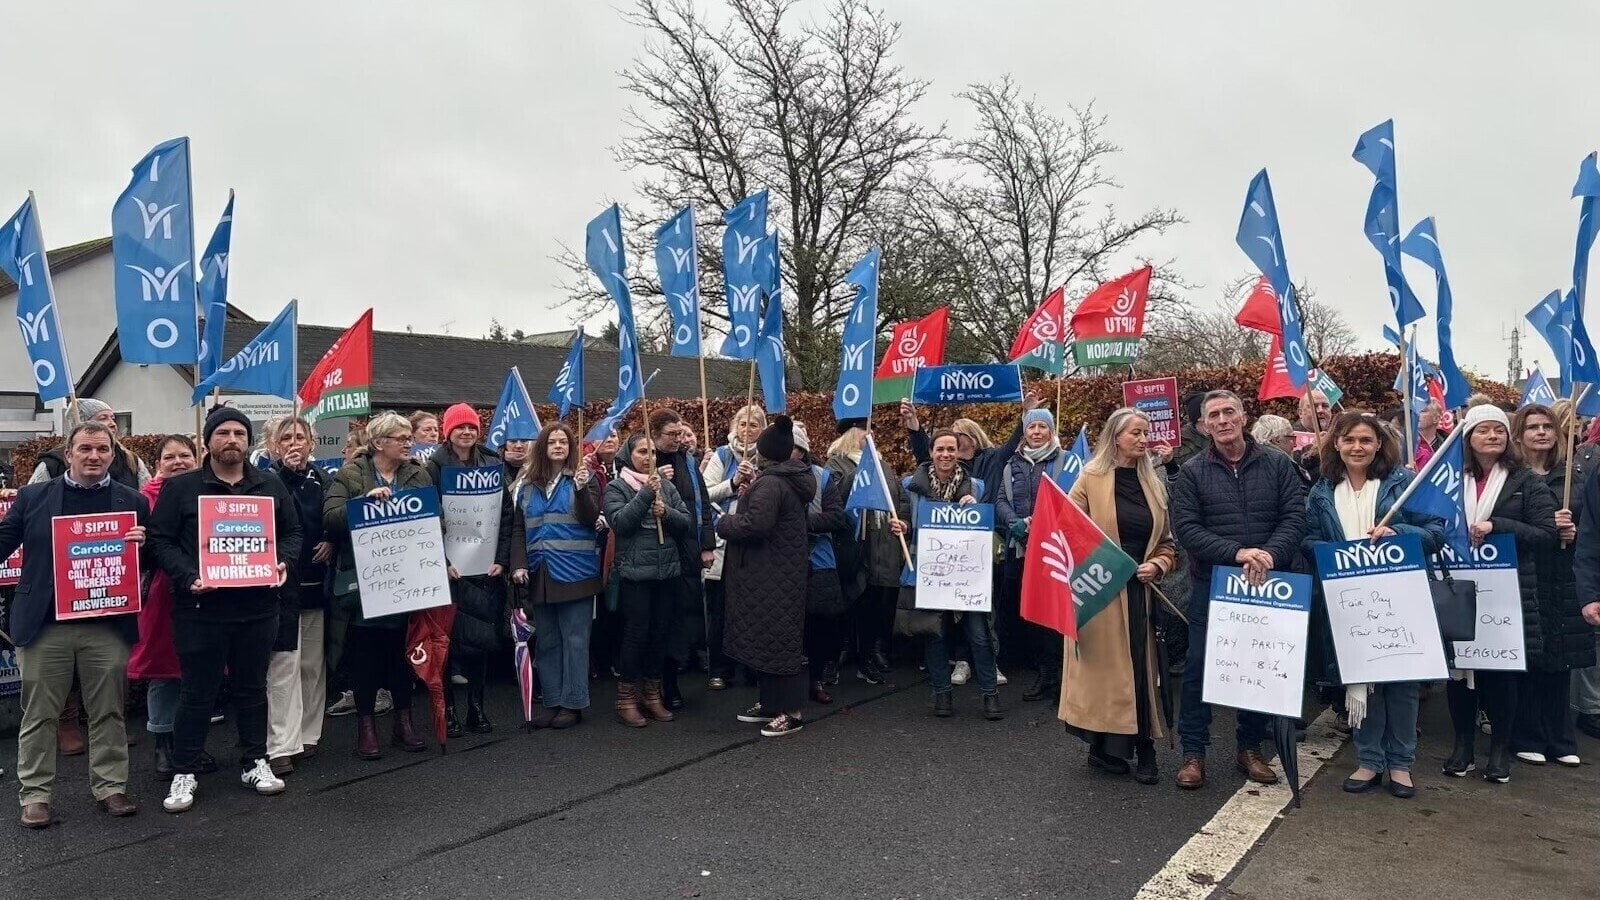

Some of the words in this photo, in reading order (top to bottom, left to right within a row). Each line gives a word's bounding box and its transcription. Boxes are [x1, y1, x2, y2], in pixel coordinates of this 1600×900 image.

[941, 369, 994, 390] INMO
[1143, 383, 1166, 394] SIPTU
[1135, 400, 1169, 409] Caredoc
[1154, 420, 1171, 432] PAY
[456, 468, 500, 489] INMO
[228, 503, 258, 513] SIPTU
[363, 494, 423, 520] INMO
[931, 504, 981, 525] INMO
[84, 520, 119, 533] SIPTU
[216, 523, 262, 533] Caredoc
[358, 527, 431, 546] CAREDOC
[71, 543, 122, 556] Caredoc
[209, 537, 267, 554] RESPECT
[371, 544, 408, 558] NEED
[417, 541, 435, 550] TO
[71, 559, 92, 571] WHY
[94, 557, 103, 568] IS
[104, 556, 122, 567] OUR
[228, 553, 249, 566] THE
[1334, 541, 1405, 571] INMO
[67, 568, 89, 581] CALL
[91, 567, 108, 578] FOR
[109, 565, 127, 576] PAY
[206, 564, 273, 580] WORKERS
[362, 562, 400, 580] CARE
[74, 575, 121, 590] INCREASES
[368, 577, 406, 592] THEIR
[1226, 573, 1293, 601] INMO
[89, 587, 107, 599] NOT
[393, 585, 442, 603] STAFF
[1370, 590, 1392, 609] Pay
[72, 595, 127, 612] ANSWERED?
[1217, 606, 1270, 626] CAREDOC
[1480, 613, 1512, 626] OUR
[1216, 635, 1238, 649] PAY
[1251, 638, 1296, 654] PARITY
[1456, 645, 1519, 661] LEAGUES
[1220, 673, 1231, 683] BE
[1239, 675, 1266, 690] FAIR
